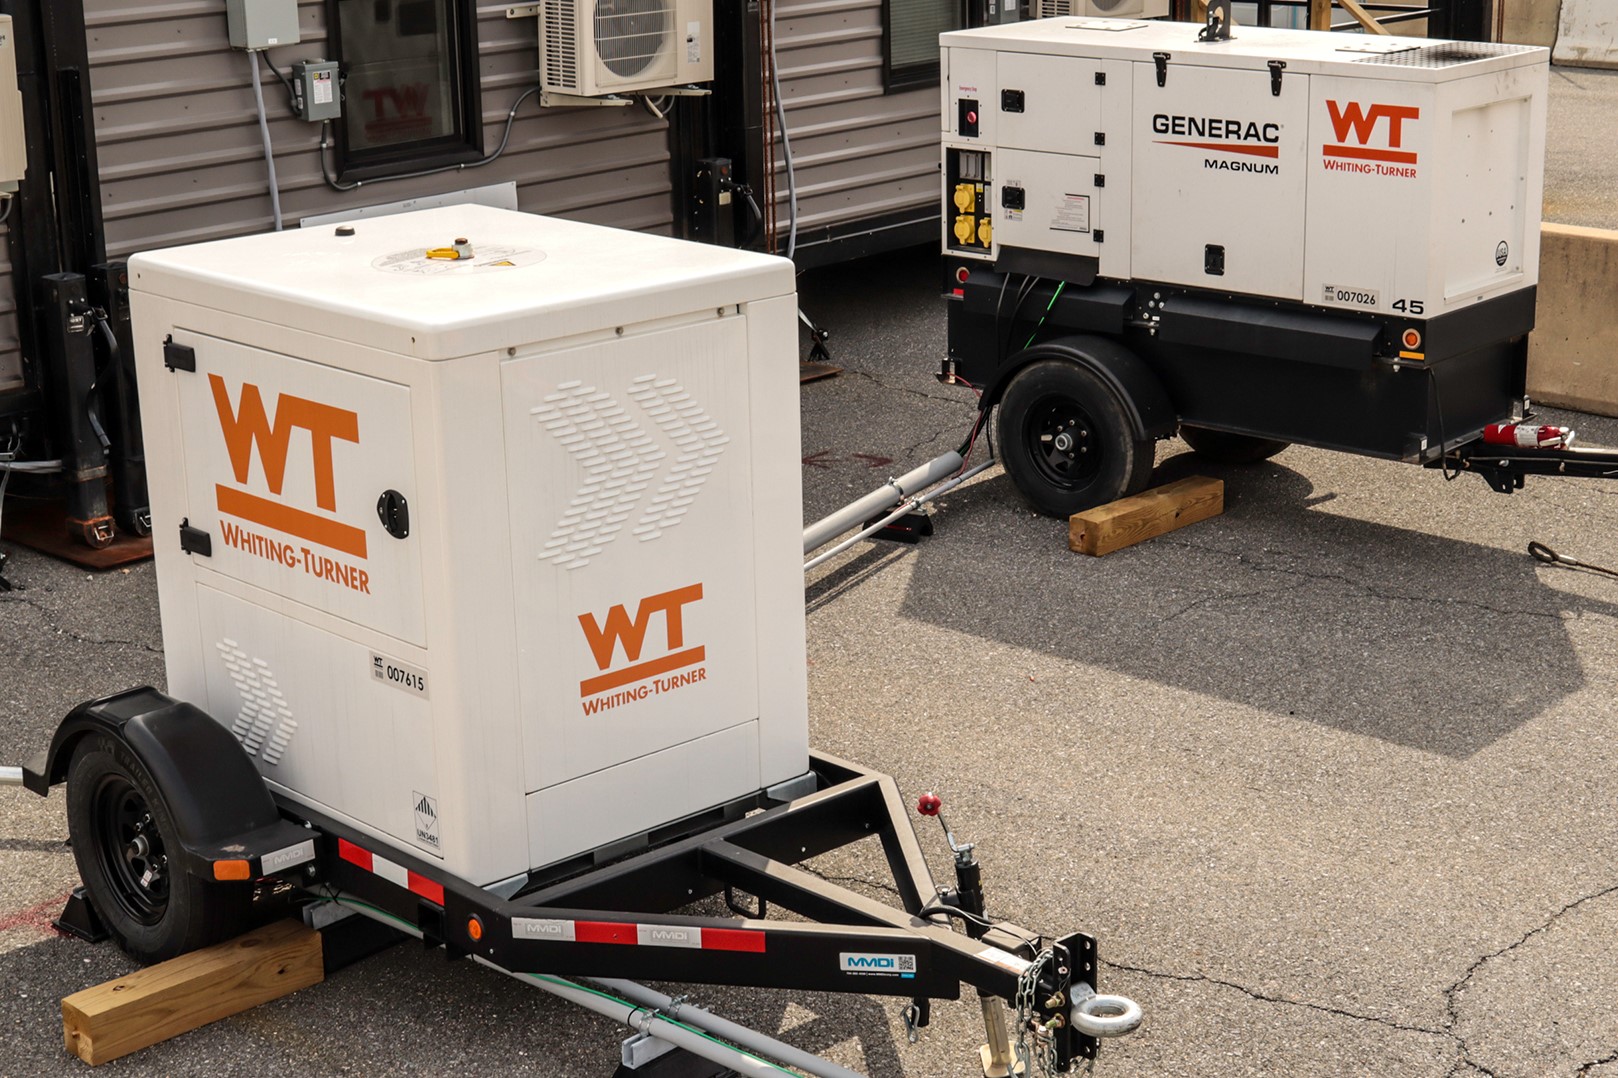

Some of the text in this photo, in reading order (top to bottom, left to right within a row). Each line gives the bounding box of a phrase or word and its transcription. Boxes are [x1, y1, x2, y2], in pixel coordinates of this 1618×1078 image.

[1153, 114, 1279, 143] GENERAC
[1325, 100, 1420, 148] WT
[1204, 159, 1279, 174] MAGNUM
[1337, 290, 1375, 304] 007026
[1392, 299, 1424, 315] 45
[207, 373, 360, 513] WT
[577, 582, 703, 671] WT
[387, 665, 424, 691] 007615
